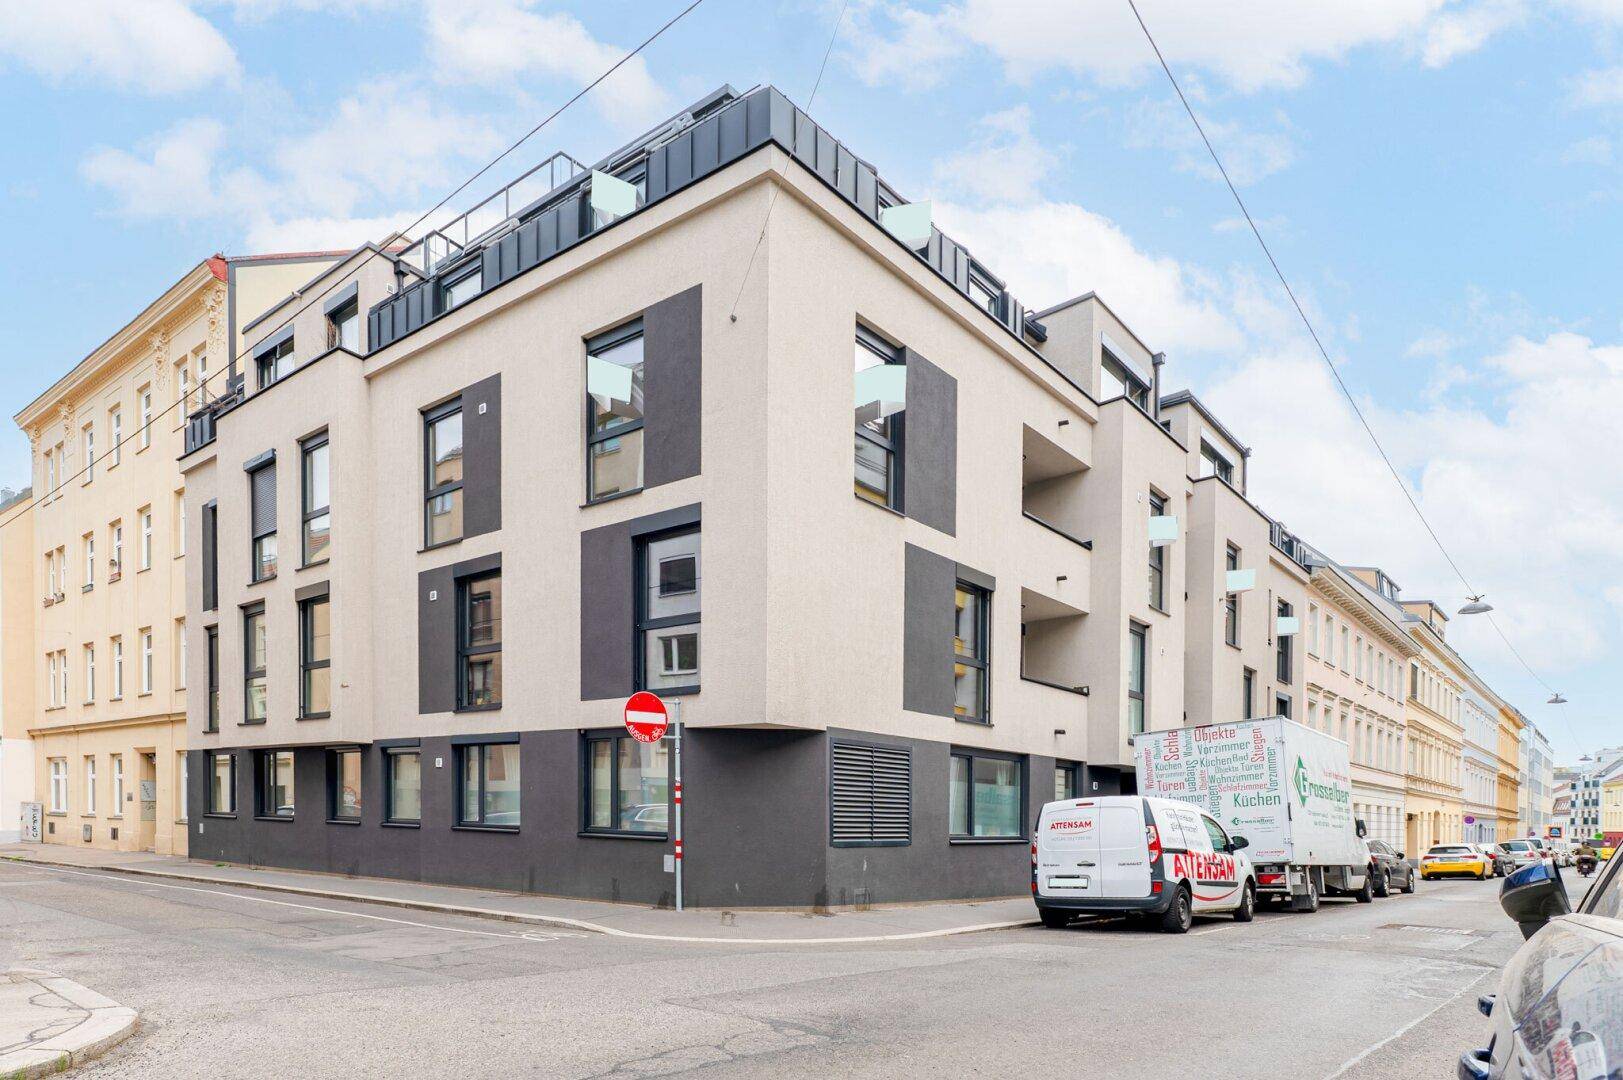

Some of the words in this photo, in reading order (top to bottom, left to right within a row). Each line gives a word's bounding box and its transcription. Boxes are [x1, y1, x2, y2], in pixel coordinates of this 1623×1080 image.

[1194, 727, 1236, 743] Objekte
[1163, 730, 1179, 761] Schla
[1197, 741, 1251, 754] Vorzimmer
[1251, 727, 1266, 763] Stiegen
[1200, 756, 1232, 768] Küchen
[1232, 753, 1249, 762] Bad
[1184, 759, 1198, 792] Stiegen
[1266, 746, 1279, 793] Vorzimmer
[1157, 780, 1185, 791] Türen
[1209, 772, 1264, 784] Wohnzimmer
[1233, 792, 1281, 808] Küchen
[1050, 821, 1092, 830] ATTENSAM
[1174, 850, 1235, 881] ATTENSAM
